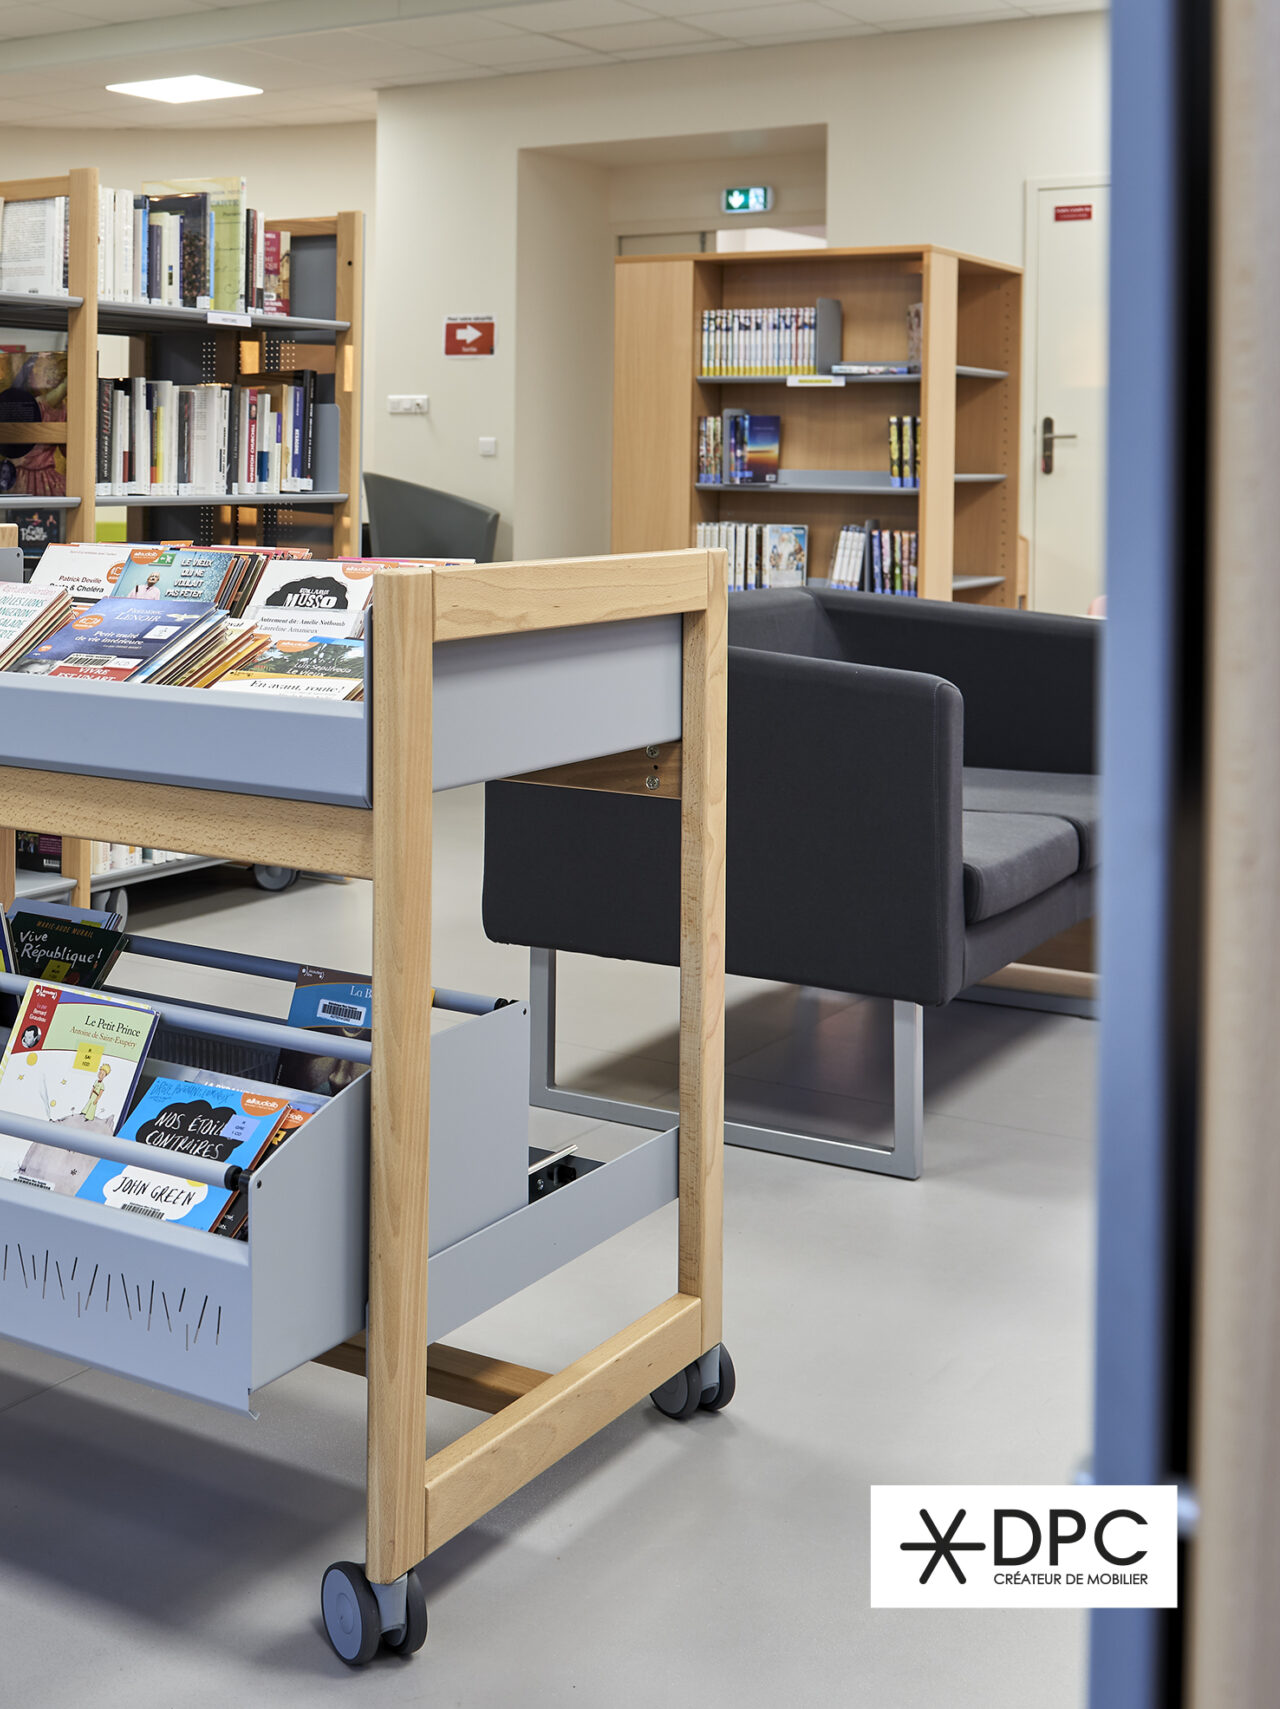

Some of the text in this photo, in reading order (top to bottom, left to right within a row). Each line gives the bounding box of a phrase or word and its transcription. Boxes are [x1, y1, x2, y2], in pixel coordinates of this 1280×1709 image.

[180, 559, 214, 568] LE VIEUX
[81, 576, 102, 584] Deville
[180, 569, 205, 578] QUI NE
[76, 584, 105, 593] Choléra
[174, 580, 204, 588] VOULAIT
[283, 593, 338, 608] MUSSO
[101, 637, 144, 645] intérieure
[20, 931, 49, 944] Vive
[70, 1026, 91, 1038] Antoine
[91, 1030, 100, 1040] de
[84, 1015, 141, 1038] Le Petit Prince
[154, 1112, 225, 1136] NOS ÉTOIL
[145, 1130, 224, 1160] CONTRAIRES
[112, 1176, 196, 1206] JOHN GREEN
